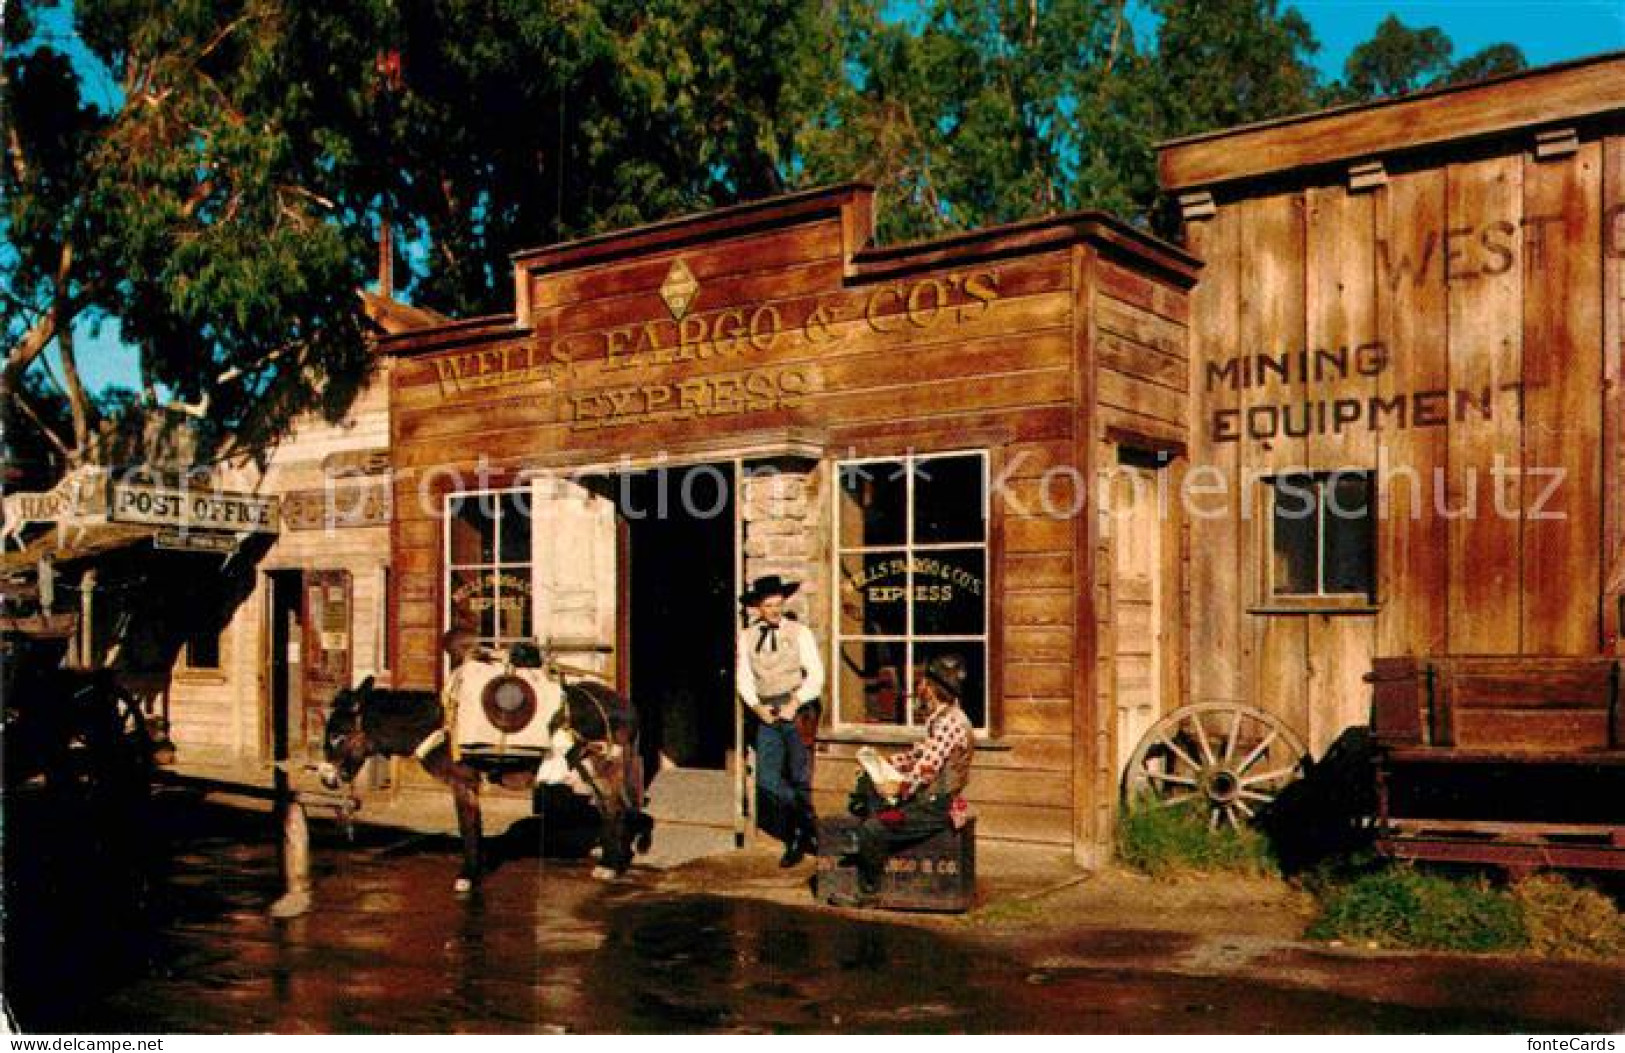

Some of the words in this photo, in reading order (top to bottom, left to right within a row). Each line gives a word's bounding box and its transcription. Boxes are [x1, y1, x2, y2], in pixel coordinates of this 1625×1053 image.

[1374, 213, 1562, 293] WEST
[430, 337, 577, 398] WELLS
[606, 306, 782, 372] FARGO
[803, 302, 838, 343] &
[1206, 341, 1390, 391] MINING
[569, 369, 806, 432] EXPRESS
[1212, 379, 1545, 443] EQUIPMENT
[119, 491, 183, 517] POST
[194, 497, 270, 524] OFFICE
